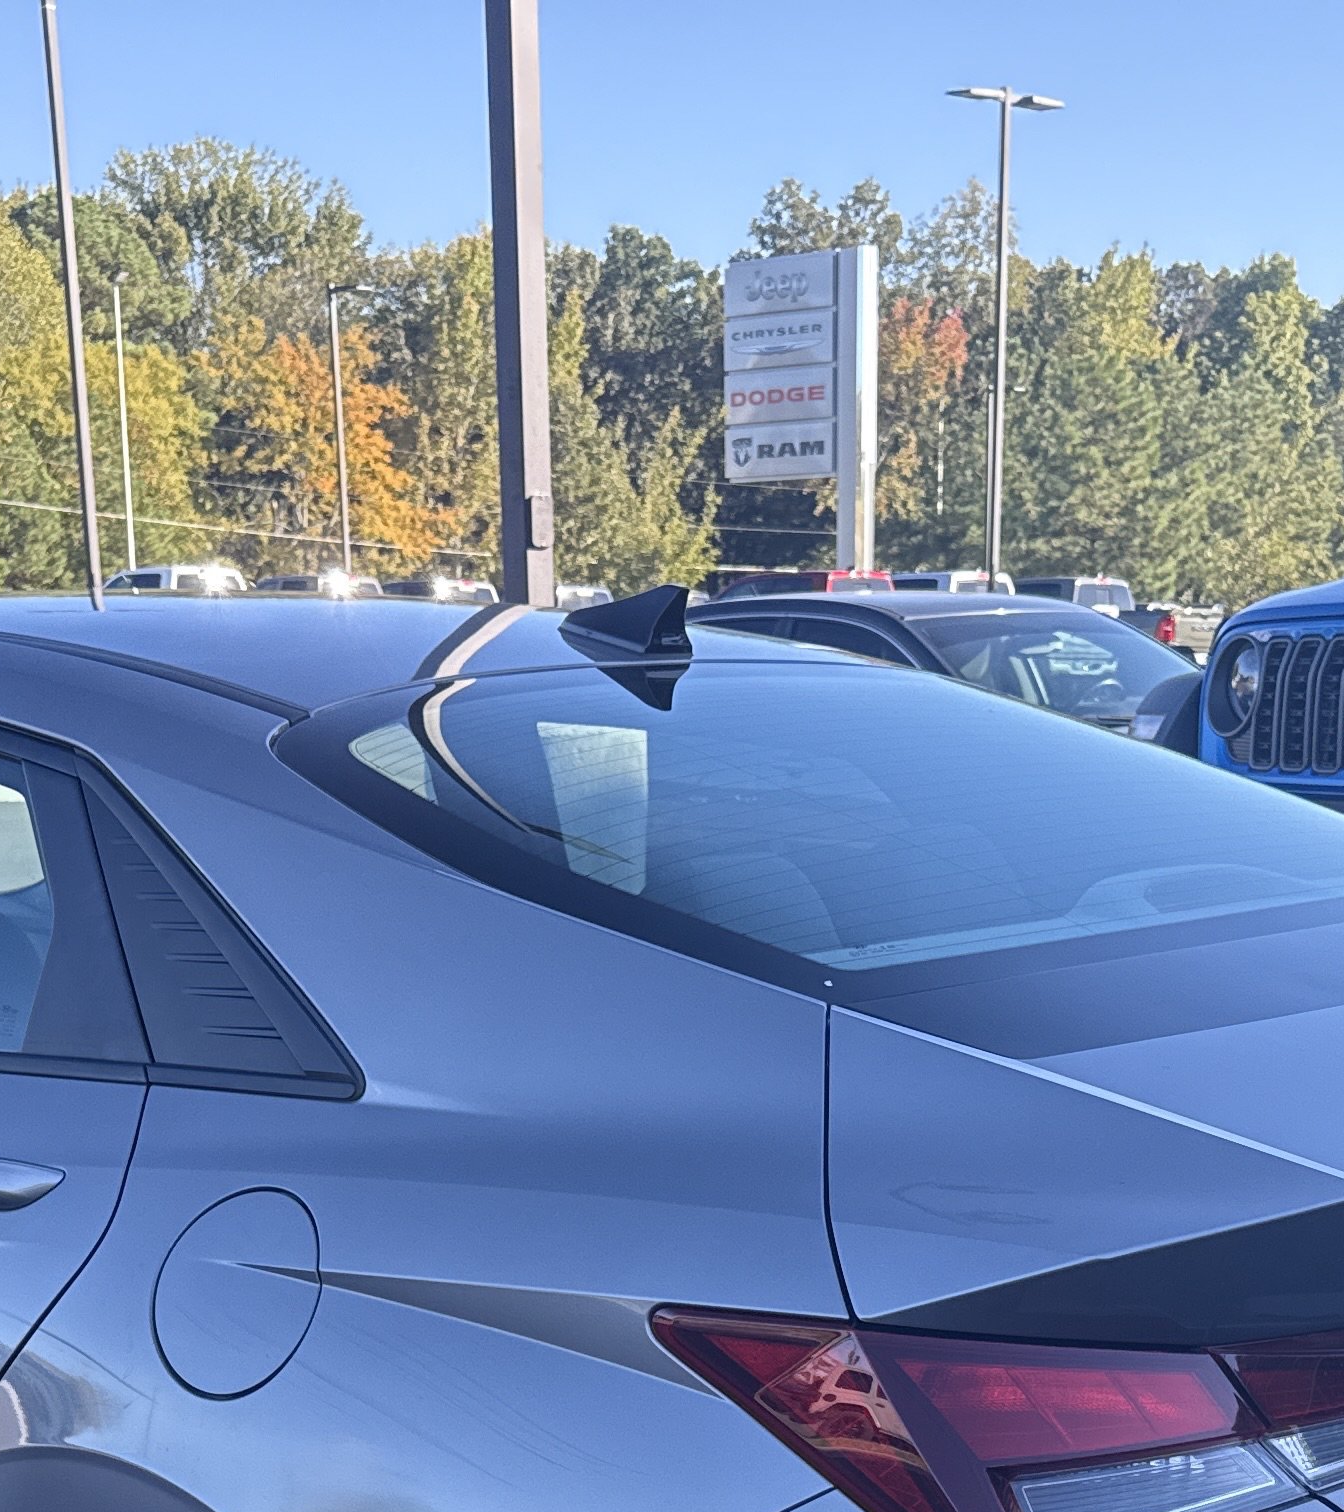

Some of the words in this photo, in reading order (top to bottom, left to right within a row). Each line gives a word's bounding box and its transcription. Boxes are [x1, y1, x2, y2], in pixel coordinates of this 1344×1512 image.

[745, 270, 809, 303] Jeep
[731, 323, 823, 342] CHRYSLER
[729, 385, 825, 408] DODGE
[757, 439, 825, 459] RAM
